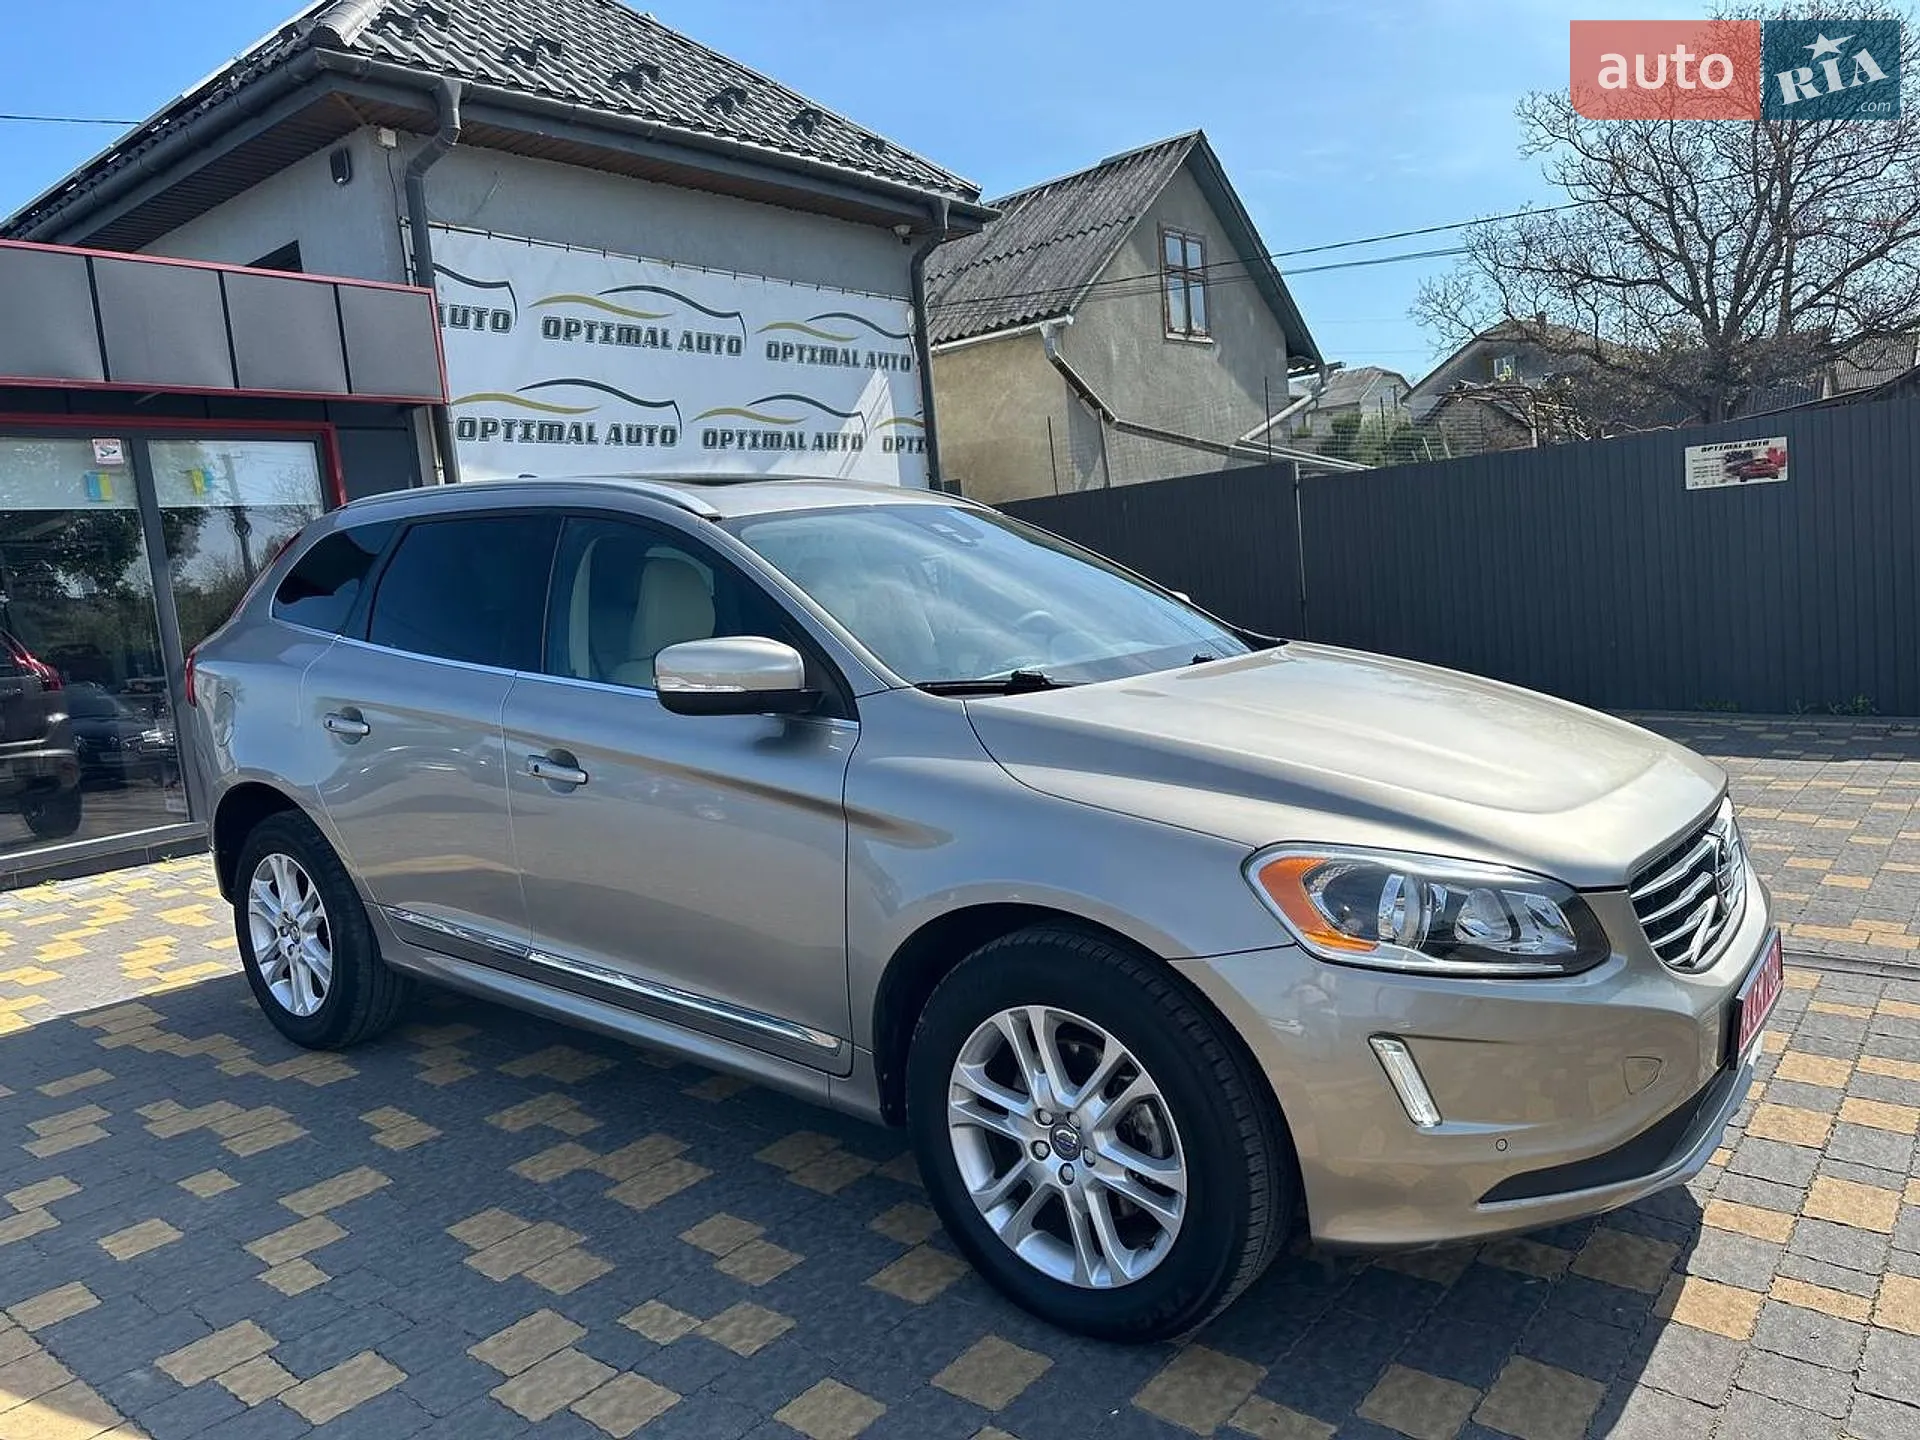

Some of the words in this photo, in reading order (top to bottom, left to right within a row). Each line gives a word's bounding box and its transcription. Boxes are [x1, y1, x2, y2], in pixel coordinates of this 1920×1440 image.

[542, 316, 673, 350] OPTIMAL
[678, 330, 742, 356] AUTO
[766, 341, 860, 368] OPTIMAL
[864, 352, 912, 372] AUTO
[456, 417, 599, 445] OPTIMAL
[604, 423, 679, 447] AUTO
[702, 428, 808, 450] OPTIMAL
[811, 432, 864, 452] AUTO
